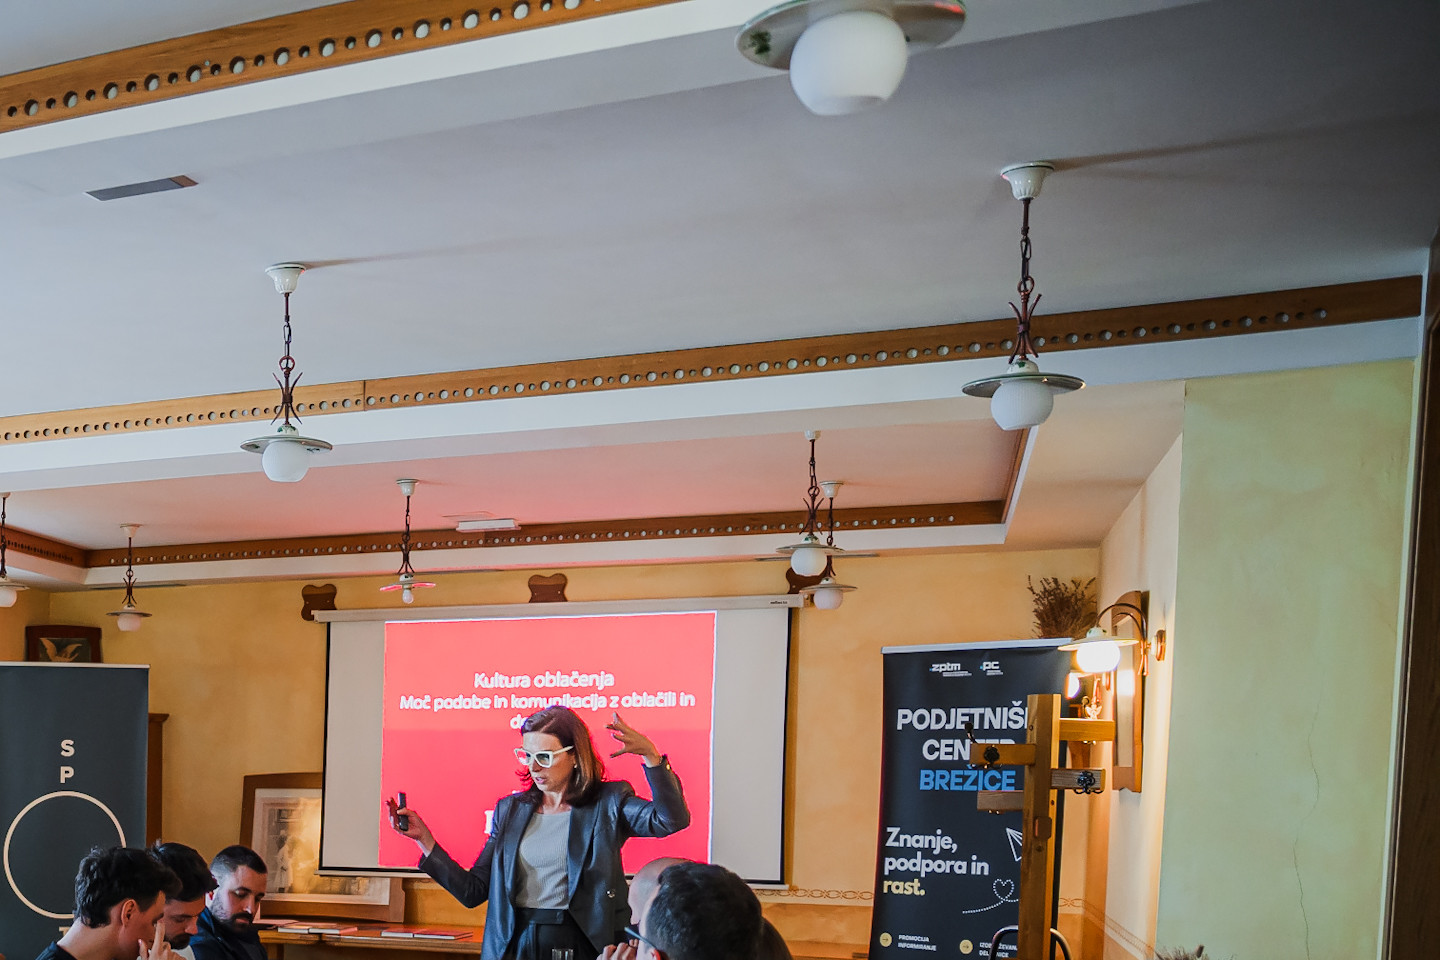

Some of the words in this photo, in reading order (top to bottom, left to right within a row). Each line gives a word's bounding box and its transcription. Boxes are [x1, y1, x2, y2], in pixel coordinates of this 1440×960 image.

[474, 672, 531, 688] Kultura
[534, 671, 614, 690] oblačenja
[400, 695, 431, 709] Moč
[434, 694, 491, 712] podobe
[494, 694, 508, 709] in
[511, 693, 607, 711] komunikacija
[609, 696, 620, 708] z
[621, 691, 676, 708] oblačili
[679, 691, 695, 707] in
[896, 700, 1027, 731] PODJETNIŠ
[922, 739, 1016, 761] CEN
[920, 764, 1016, 791] BREŽICE
[885, 827, 958, 854] Znanje,
[884, 852, 967, 877] podpora
[970, 855, 990, 875] in
[883, 878, 926, 897] rast.
